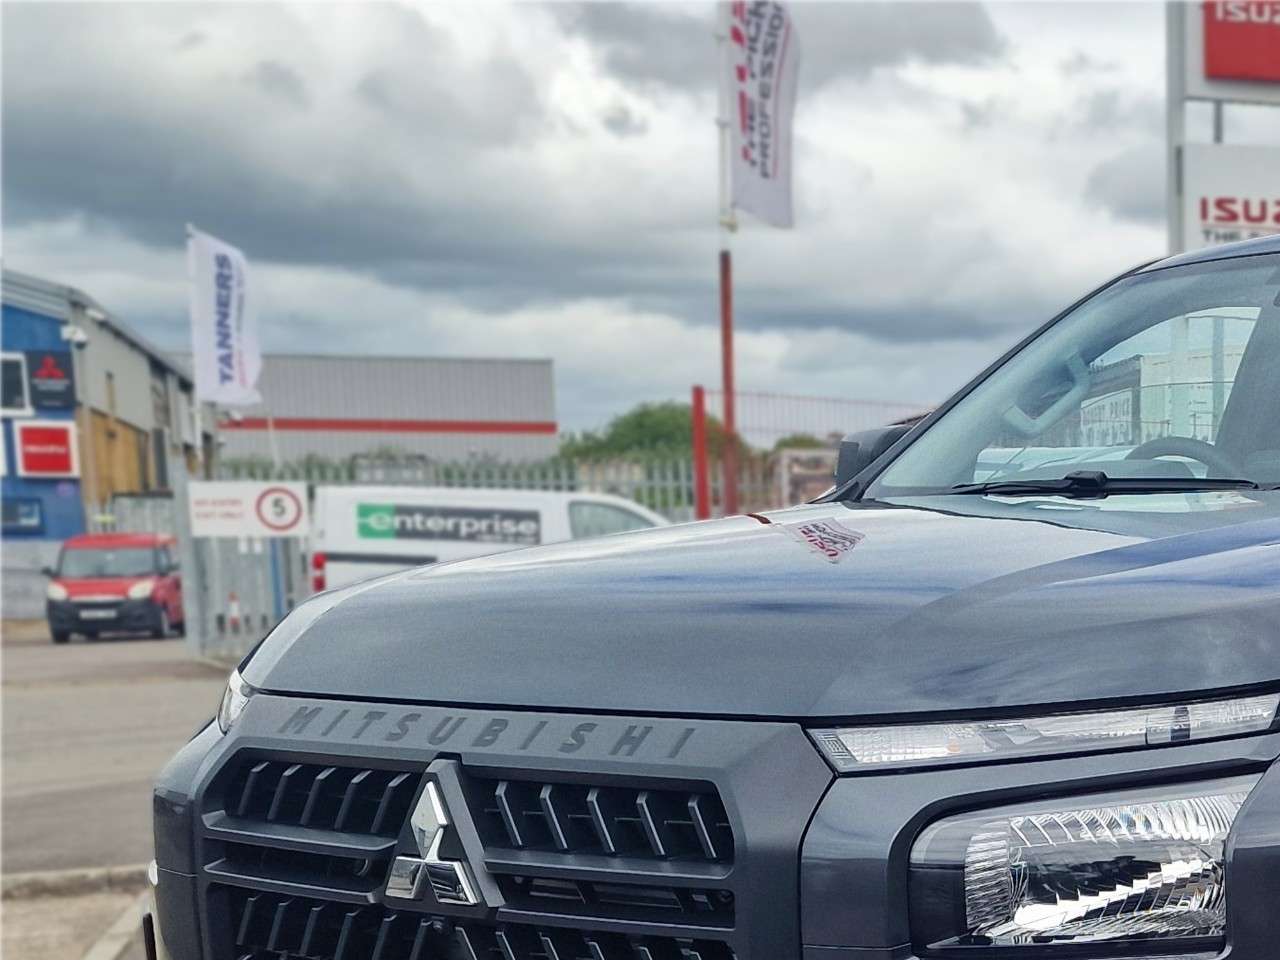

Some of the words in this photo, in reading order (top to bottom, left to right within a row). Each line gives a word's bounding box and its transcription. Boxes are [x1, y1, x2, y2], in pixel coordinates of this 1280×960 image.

[214, 253, 234, 386] TANNERS
[272, 497, 286, 517] 5
[368, 505, 539, 538] enterprise
[279, 705, 697, 759] MITSUBISHI
